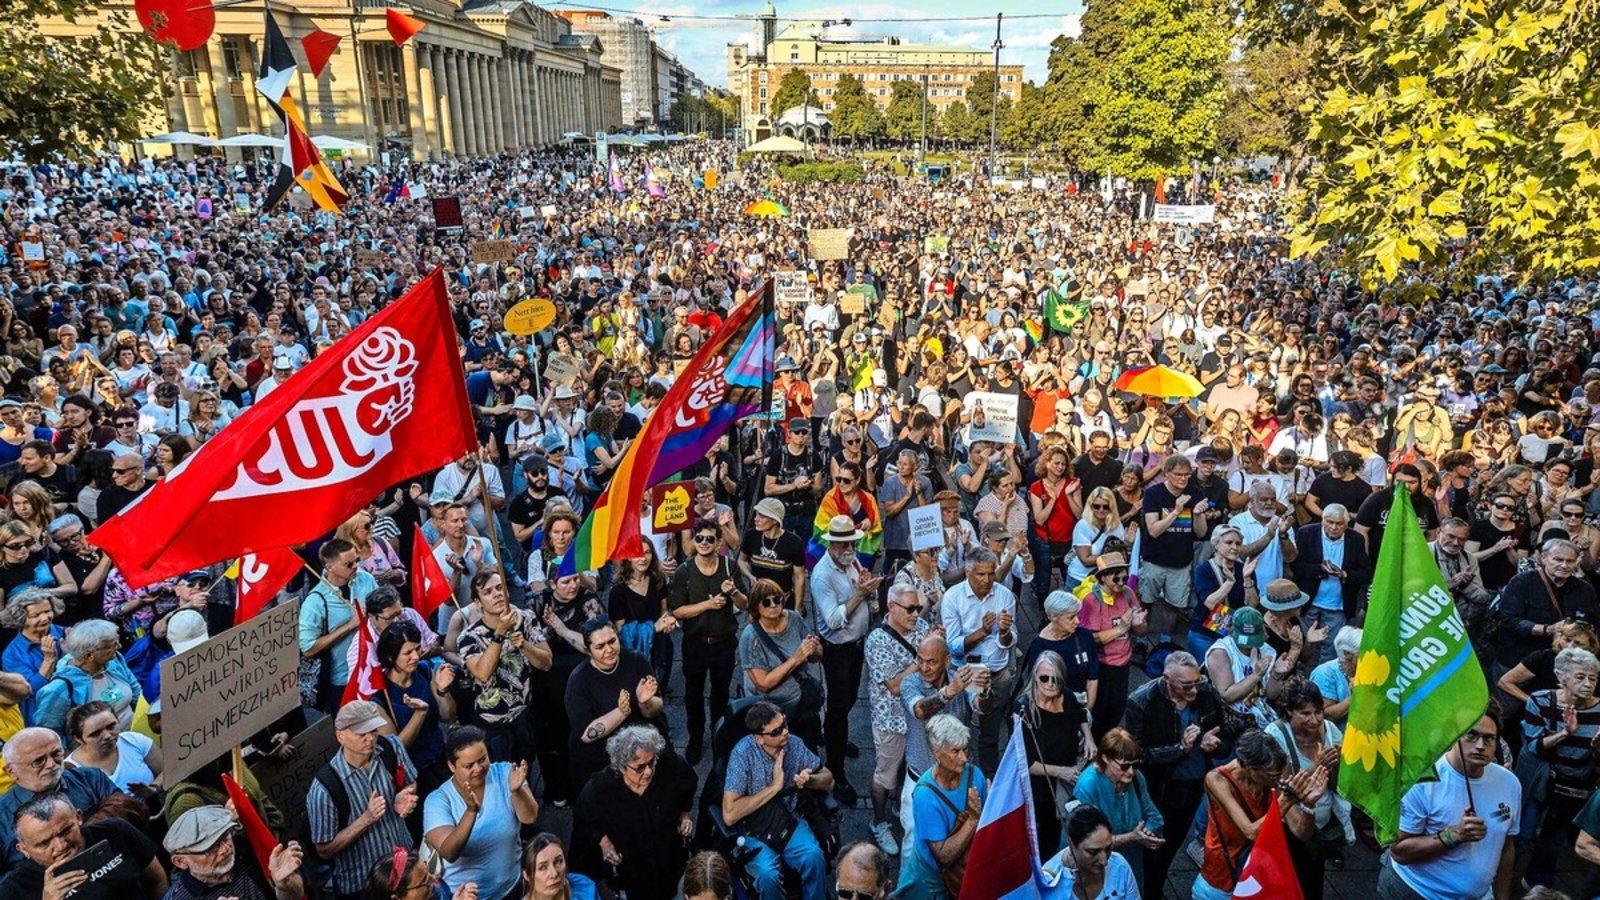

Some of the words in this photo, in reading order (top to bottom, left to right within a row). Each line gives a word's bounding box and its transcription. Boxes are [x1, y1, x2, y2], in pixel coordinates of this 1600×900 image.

[665, 496, 679, 505] THE
[665, 512, 685, 521] LAND
[915, 515, 935, 525] OMAS
[914, 521, 937, 531] GEGEN
[914, 528, 940, 538] RECHTS
[170, 653, 245, 708] WÄHLEN
[252, 623, 299, 662] SONST
[90, 853, 123, 882] JONES
